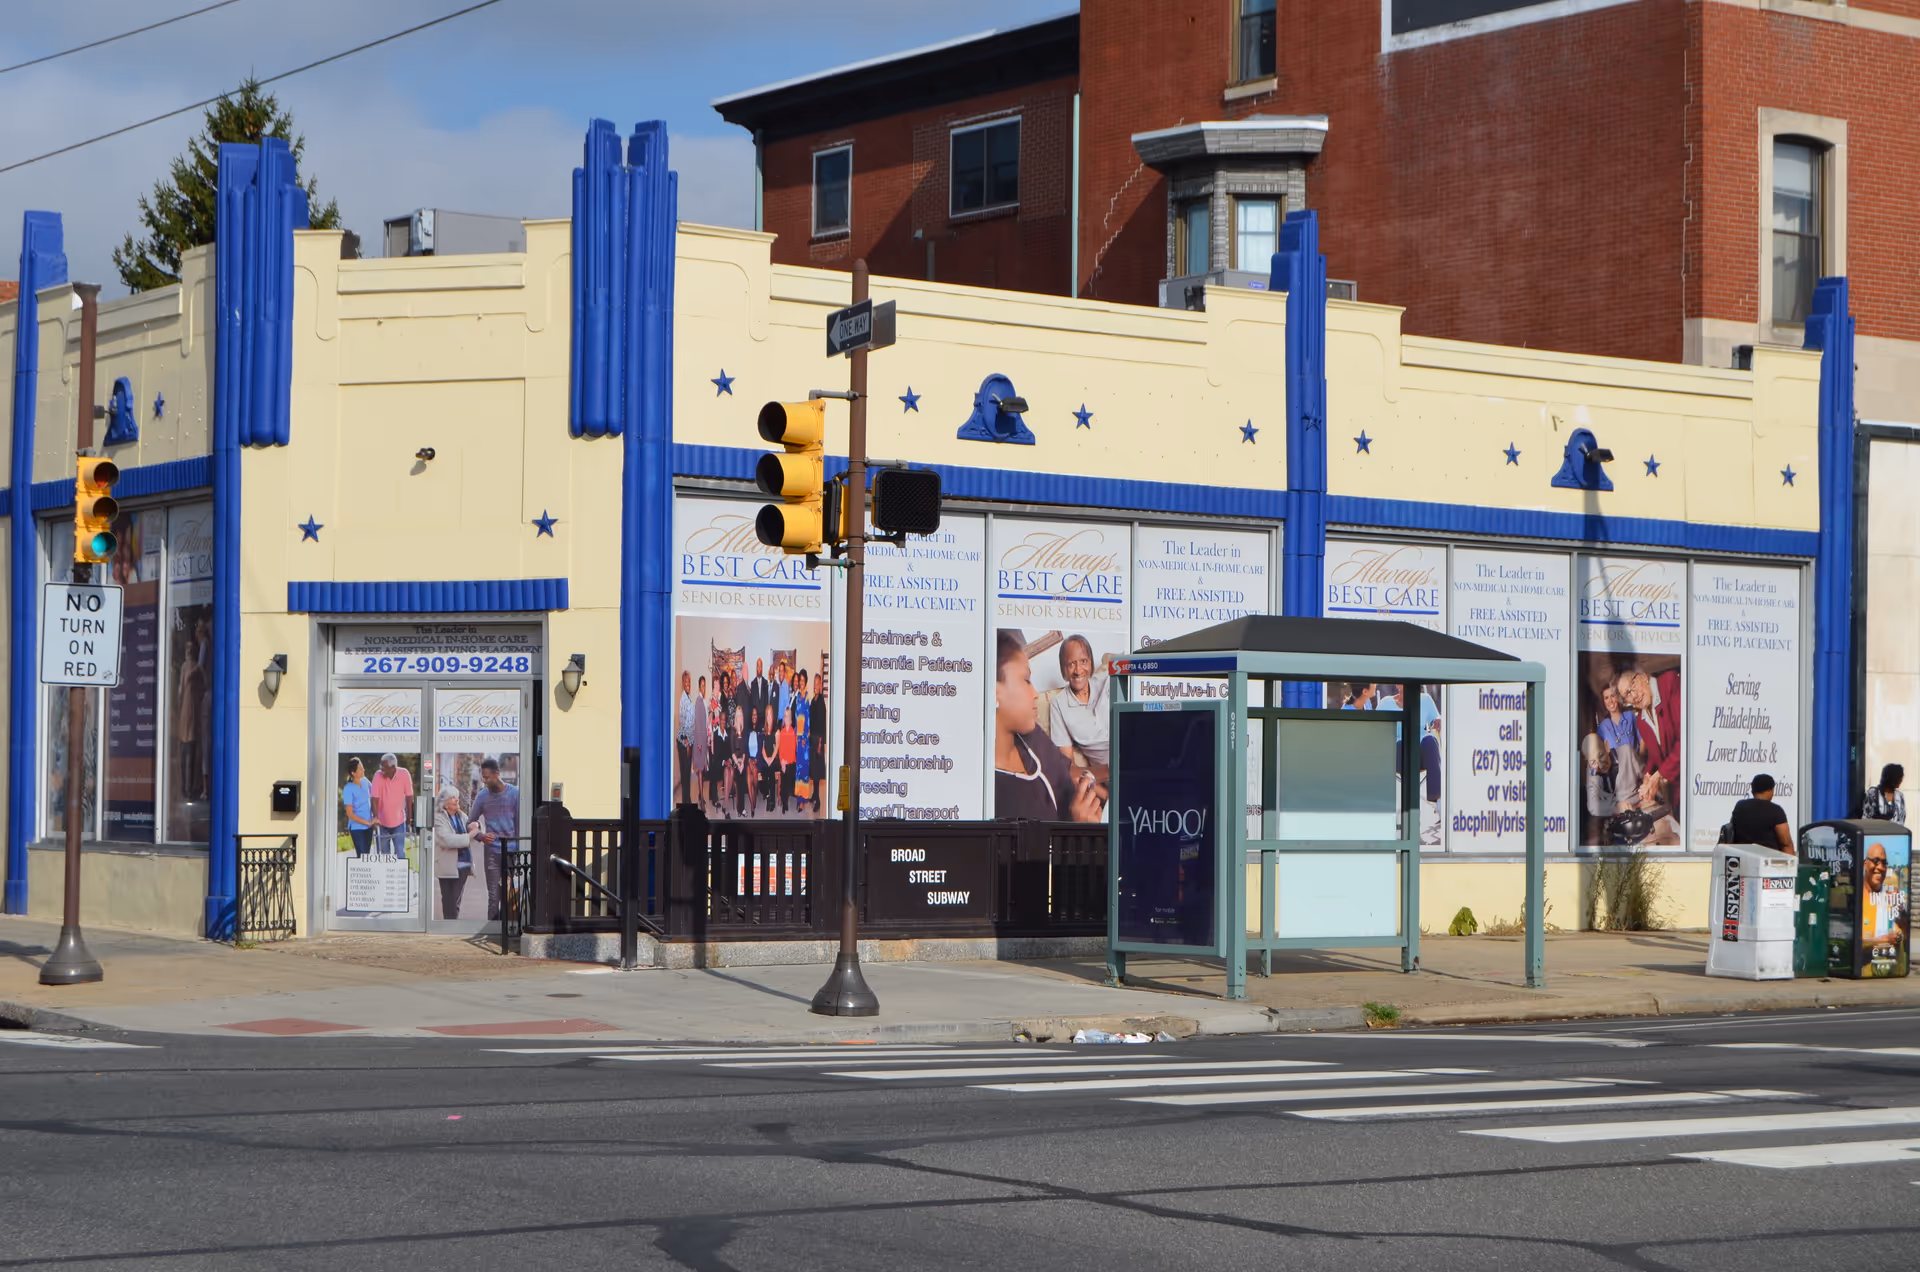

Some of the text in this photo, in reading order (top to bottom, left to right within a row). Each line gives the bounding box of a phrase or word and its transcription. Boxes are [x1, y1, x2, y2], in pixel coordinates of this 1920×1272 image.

[840, 314, 867, 339] ONE WAY
[944, 529, 955, 543] in
[913, 548, 955, 560] IN-HOME
[957, 551, 981, 561] CARE
[1163, 540, 1241, 558] The Leader in
[170, 555, 213, 578] BEST CA
[682, 554, 821, 581] BEST CARE
[907, 562, 914, 572] &
[1001, 529, 1117, 594] Always
[1138, 560, 1265, 575] NON-MEDICAL IN-HOME CARE
[1198, 576, 1203, 585] &
[1331, 545, 1435, 608] Always
[1476, 564, 1544, 580] The Leader in
[863, 574, 958, 591] FREE ASSISTED
[998, 570, 1122, 595] BEST CARE
[1454, 582, 1566, 596] NON-MEDICAL IN-HOME CARE
[1584, 562, 1676, 619] Always
[1713, 577, 1776, 593] The Leader in
[66, 593, 101, 612] NO
[682, 590, 821, 608] SENIOR SERVICES
[896, 596, 976, 611] PLACEMENT
[1157, 588, 1244, 604] FREE ASSISTED
[1328, 584, 1439, 607] BEST CARE
[1506, 596, 1512, 606] &
[1695, 594, 1742, 605] NON-MEDICAL
[1778, 599, 1795, 608] CARE
[998, 604, 1122, 621] SENIOR SERVICES
[1143, 605, 1185, 620] LIVING
[1470, 608, 1547, 623] FREE ASSISTED
[1580, 599, 1680, 620] BEST CARE
[60, 617, 105, 634] TURN
[415, 625, 477, 633] The Leader in
[1458, 625, 1561, 640] LIVING PLACEMENT
[1708, 619, 1779, 633] FREE ASSISTED
[364, 635, 528, 645] NON-MEDICAL IN-HOME CARE
[862, 629, 942, 647] zheimer's &
[1581, 629, 1680, 643] SENIOR SERVICES
[1696, 635, 1792, 651] LIVING PLACEMENT
[69, 640, 94, 655] ON
[345, 647, 353, 655] &
[355, 647, 382, 655] FREE
[384, 646, 436, 655] ASSISTED
[439, 646, 477, 654] LIVING
[64, 661, 97, 677] RED
[363, 656, 529, 673] 267-909-9248
[861, 655, 973, 673] ementia Patients
[861, 680, 957, 697] ancer Patients
[1140, 681, 1216, 699] Hourly/Live-in
[1726, 672, 1761, 701] Serving
[1479, 688, 1527, 711] informat
[343, 691, 417, 727] Always
[440, 691, 514, 727] Always
[860, 704, 900, 723] athing
[341, 715, 419, 728] BEST CARE
[438, 715, 518, 728] BEST CARE
[1712, 706, 1772, 734] Philadelphia,
[860, 729, 940, 745] omfort Care
[1499, 720, 1522, 741] call:
[1706, 740, 1777, 764] Lower Bucks &
[859, 754, 953, 773] ompanionship
[1472, 749, 1500, 776] (267)
[859, 779, 908, 798] ressing
[1487, 785, 1500, 801] or
[1693, 773, 1751, 800] Surrounding
[859, 804, 959, 819] scort/Transport
[1128, 806, 1206, 838] YAHOO!
[361, 854, 397, 864] HOURS
[891, 849, 926, 862] BROAD
[909, 870, 946, 883] STREET
[927, 891, 970, 904] SUBWAY
